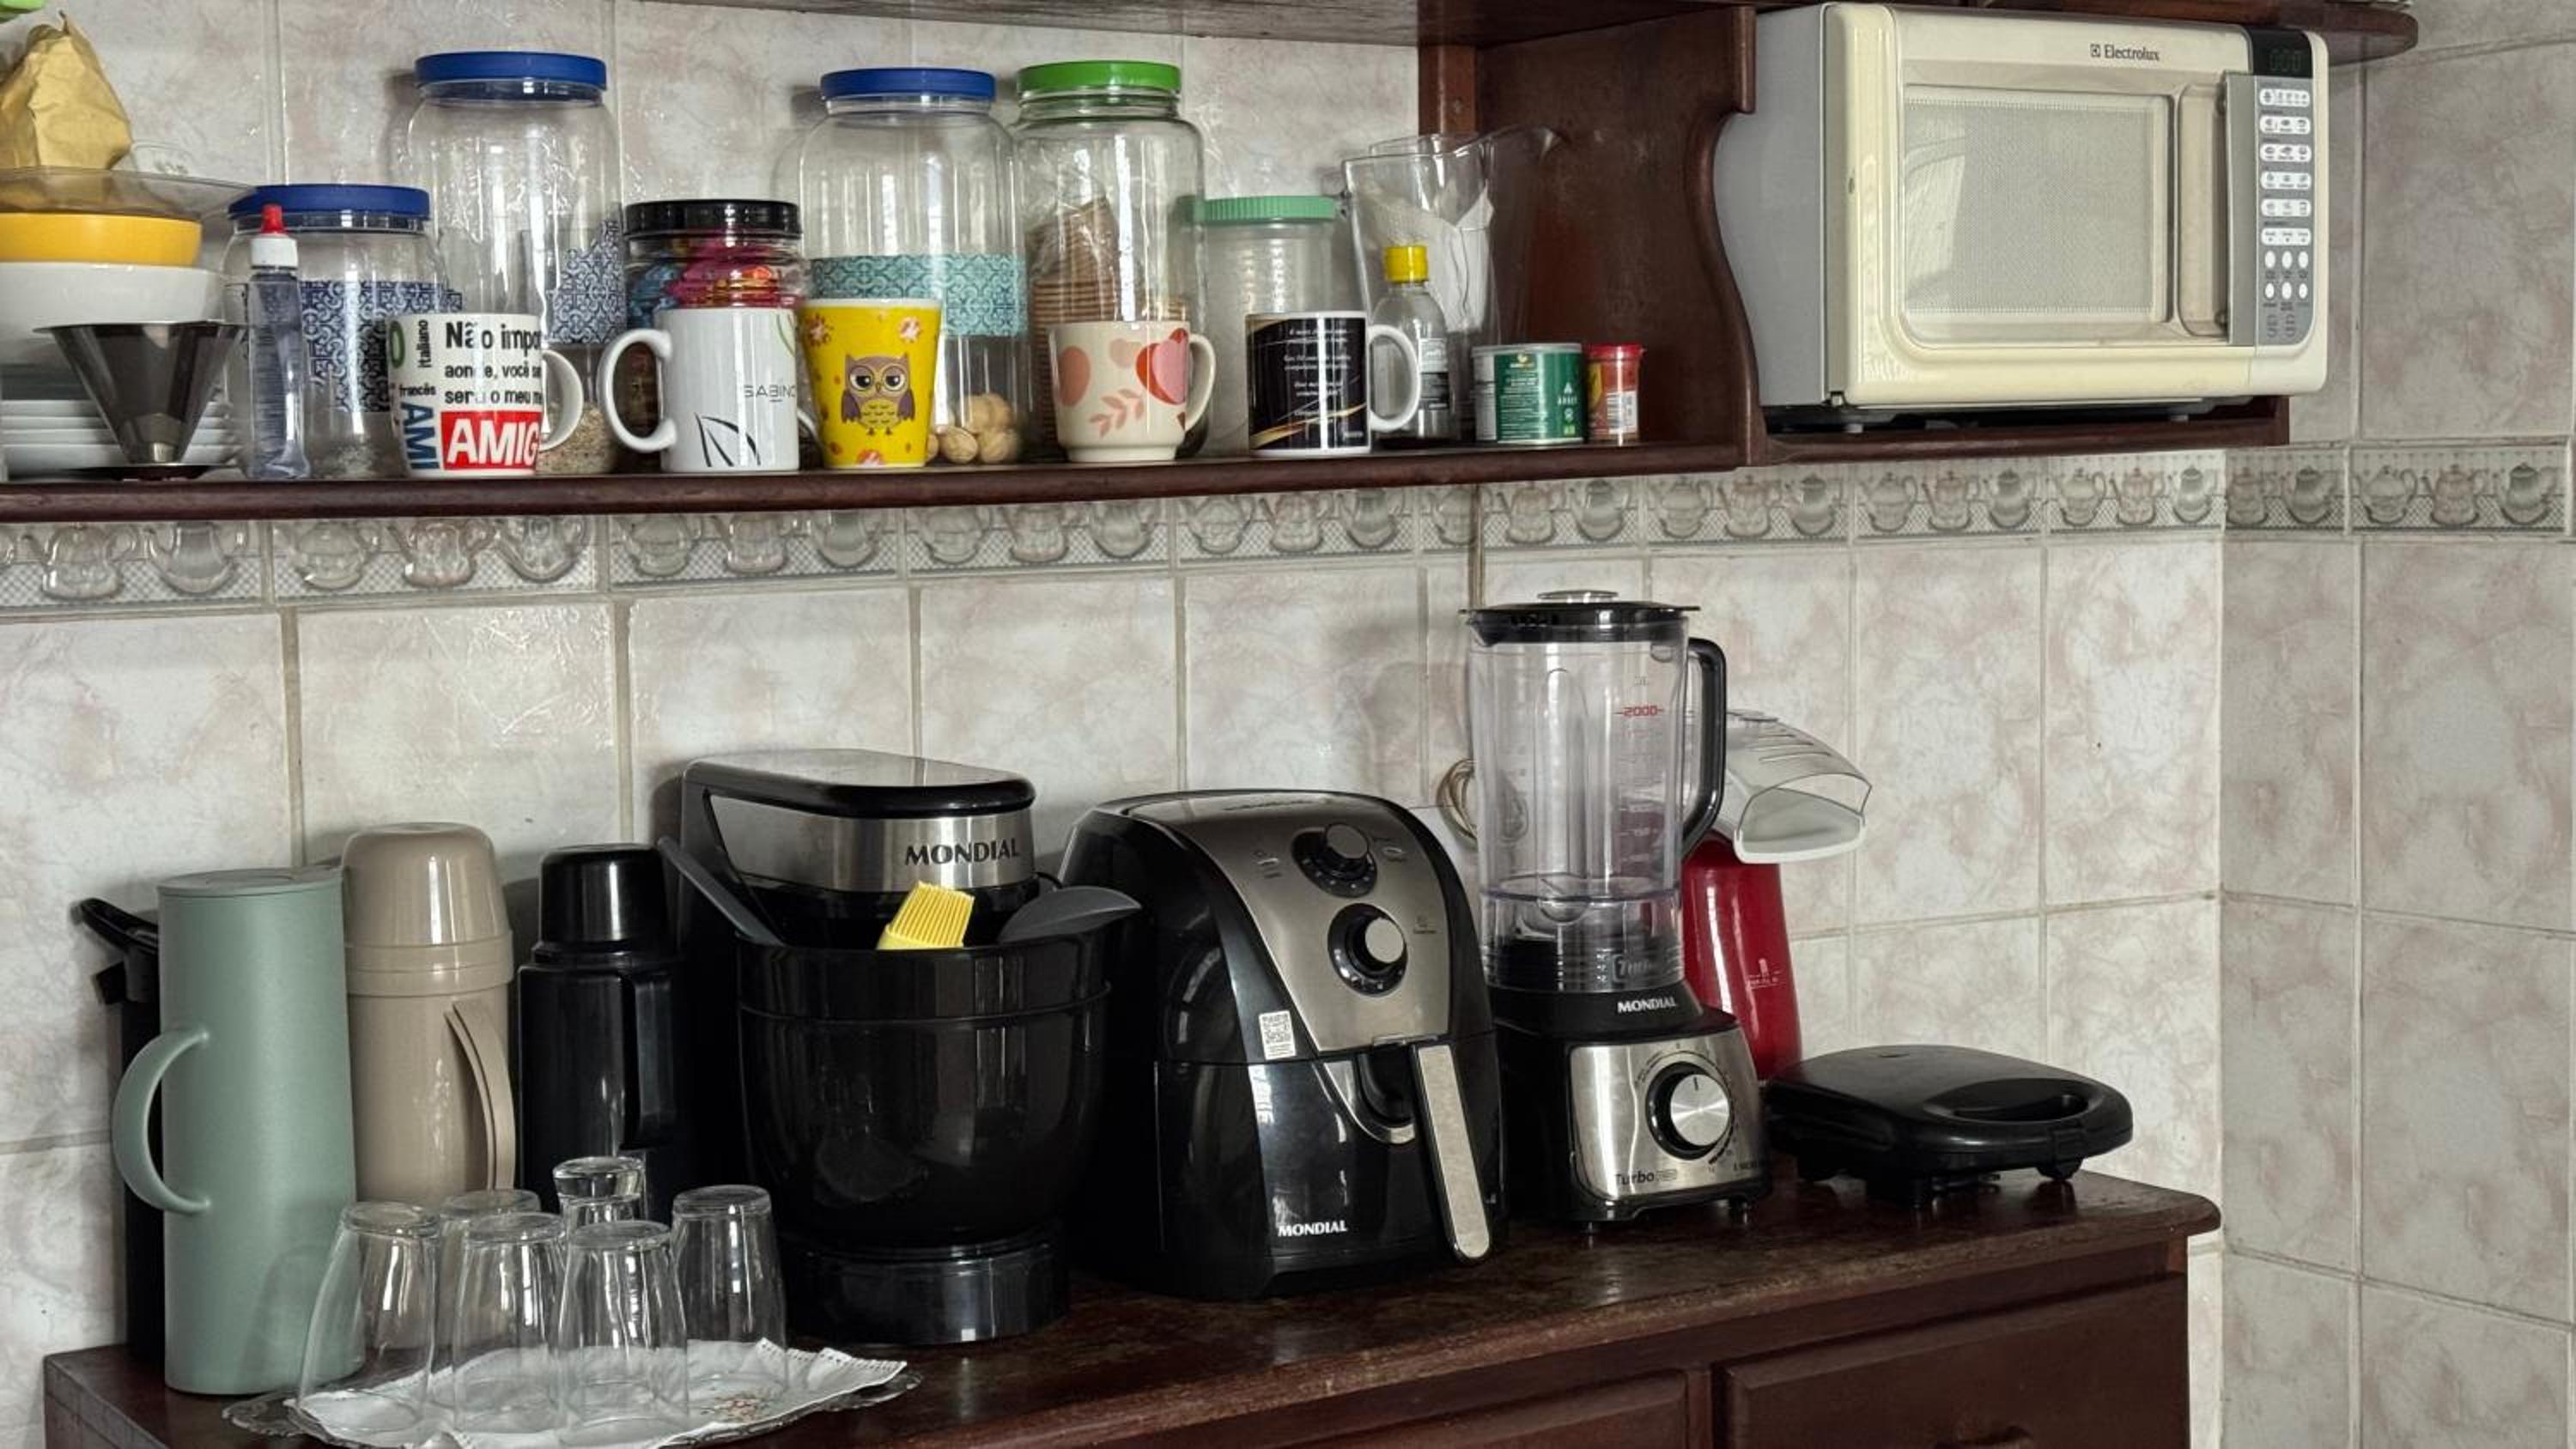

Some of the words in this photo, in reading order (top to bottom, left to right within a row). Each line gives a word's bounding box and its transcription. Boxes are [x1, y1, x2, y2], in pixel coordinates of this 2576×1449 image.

[2105, 45, 2160, 61] Electrolux
[445, 321, 495, 349] Não
[445, 364, 498, 379] aone,
[501, 361, 530, 379] você
[490, 391, 501, 404] o
[504, 390, 531, 404] meu
[904, 837, 1019, 865] MONDIAL
[1617, 996, 1677, 1014] MONDIAL
[1614, 1170, 1655, 1186] Turbo
[1278, 1219, 1348, 1237] MONDIAL
